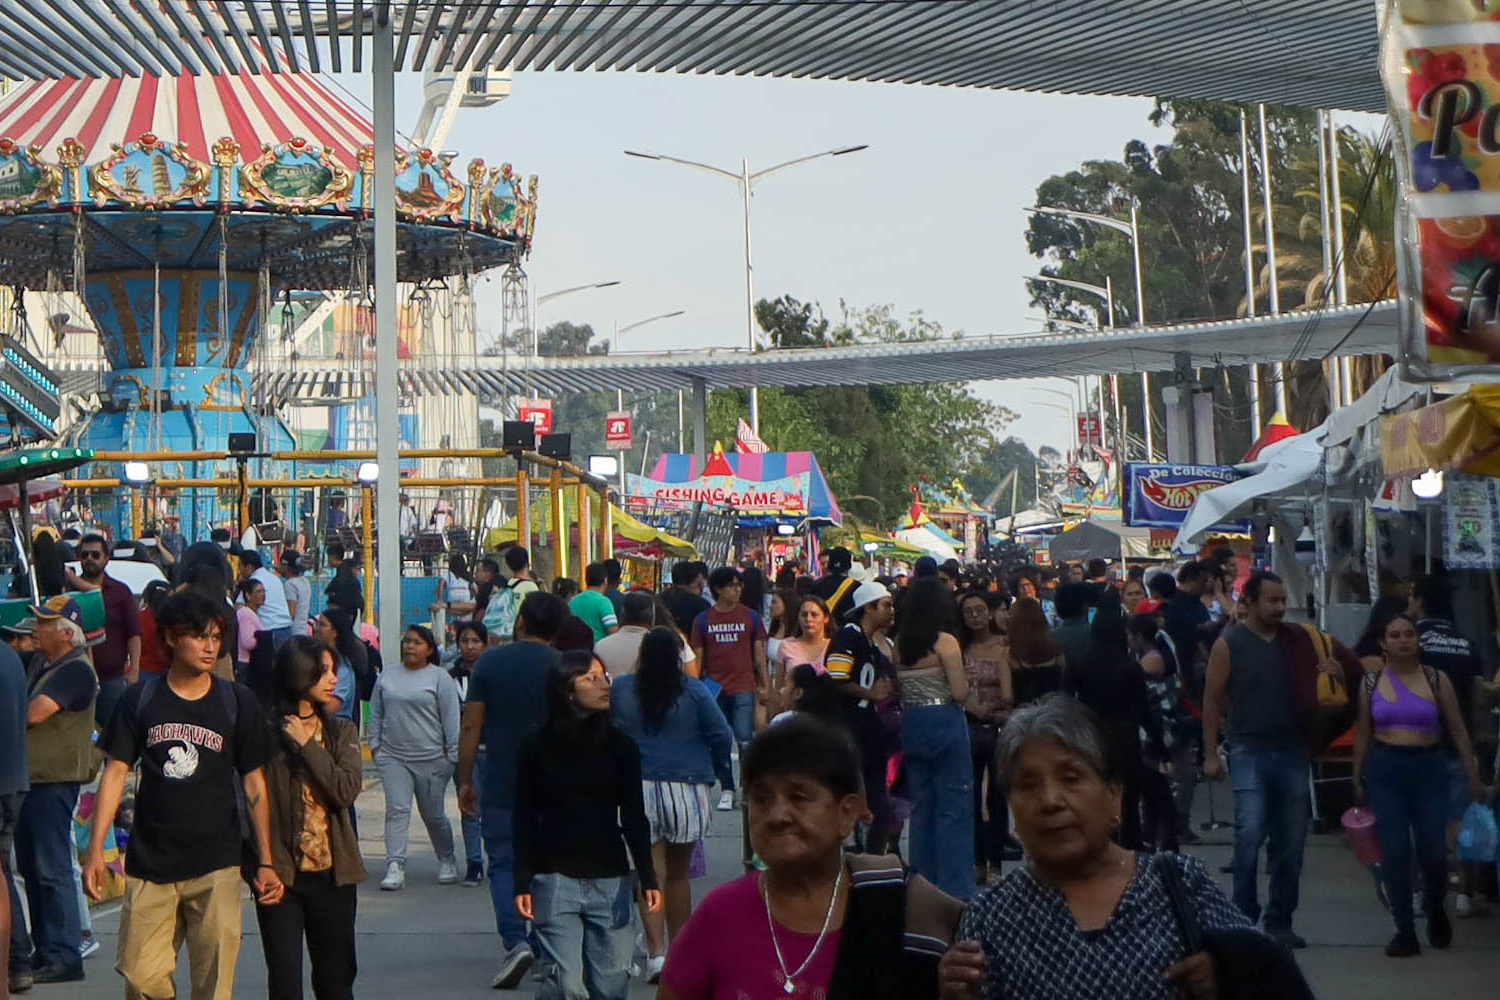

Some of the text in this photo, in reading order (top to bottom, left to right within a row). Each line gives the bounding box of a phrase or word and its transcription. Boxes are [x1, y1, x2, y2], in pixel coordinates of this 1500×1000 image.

[1150, 469, 1169, 480] De
[655, 487, 777, 506] FISHING GAME
[708, 623, 746, 633] AMERICAN
[715, 633, 739, 642] EAGLE
